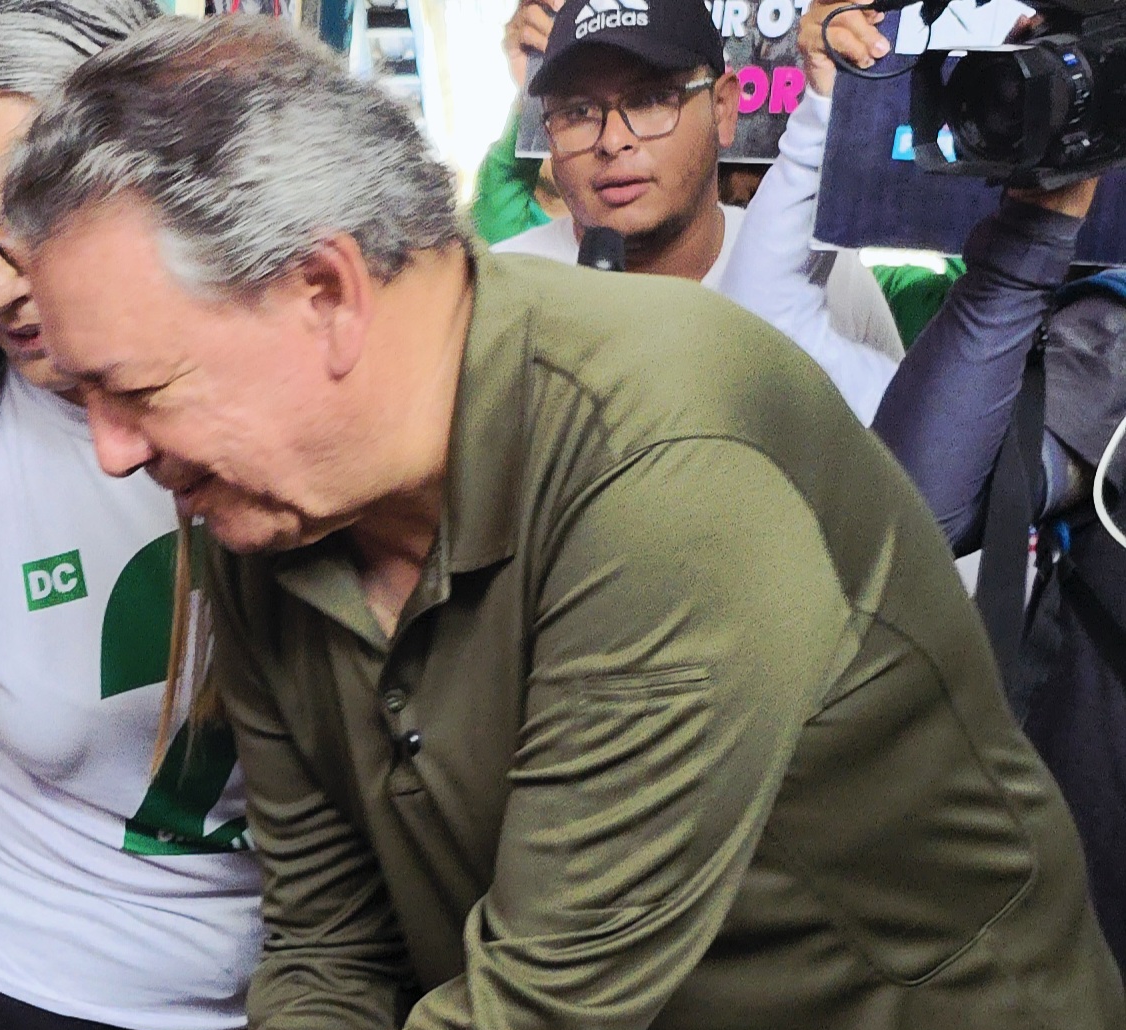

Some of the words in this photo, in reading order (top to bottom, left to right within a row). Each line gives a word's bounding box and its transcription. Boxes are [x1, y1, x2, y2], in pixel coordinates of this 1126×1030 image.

[575, 9, 649, 39] adidas
[705, 0, 749, 38] IR
[725, 64, 806, 114] OR
[27, 562, 78, 601] DC
